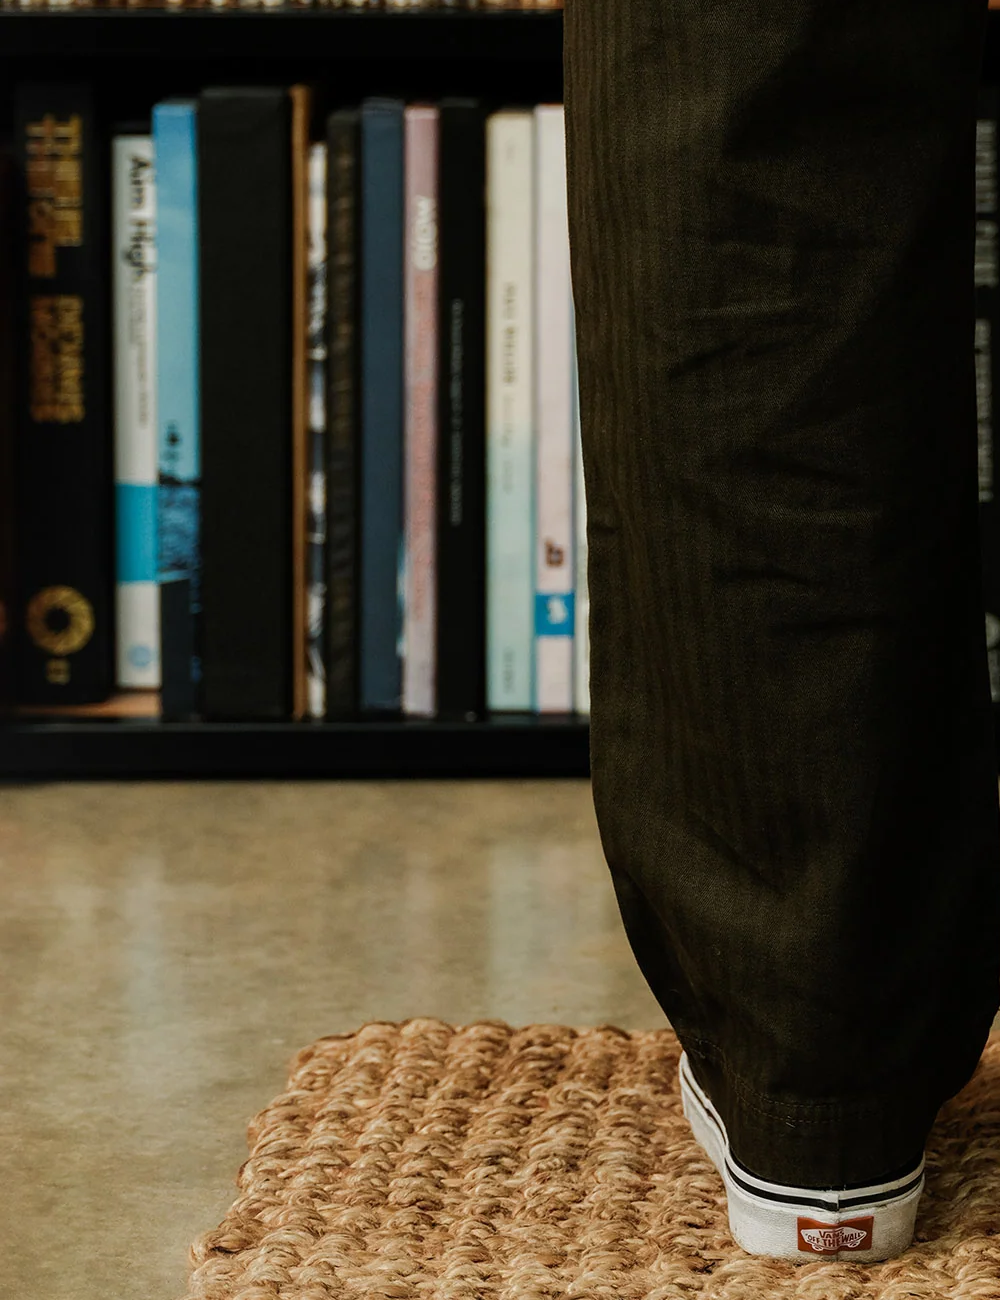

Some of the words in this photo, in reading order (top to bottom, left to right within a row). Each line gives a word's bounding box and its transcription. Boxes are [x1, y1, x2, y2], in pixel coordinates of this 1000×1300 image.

[131, 156, 155, 207] Aim
[122, 219, 156, 282] High
[819, 1228, 844, 1239] VANS
[823, 1238, 840, 1247] THE
